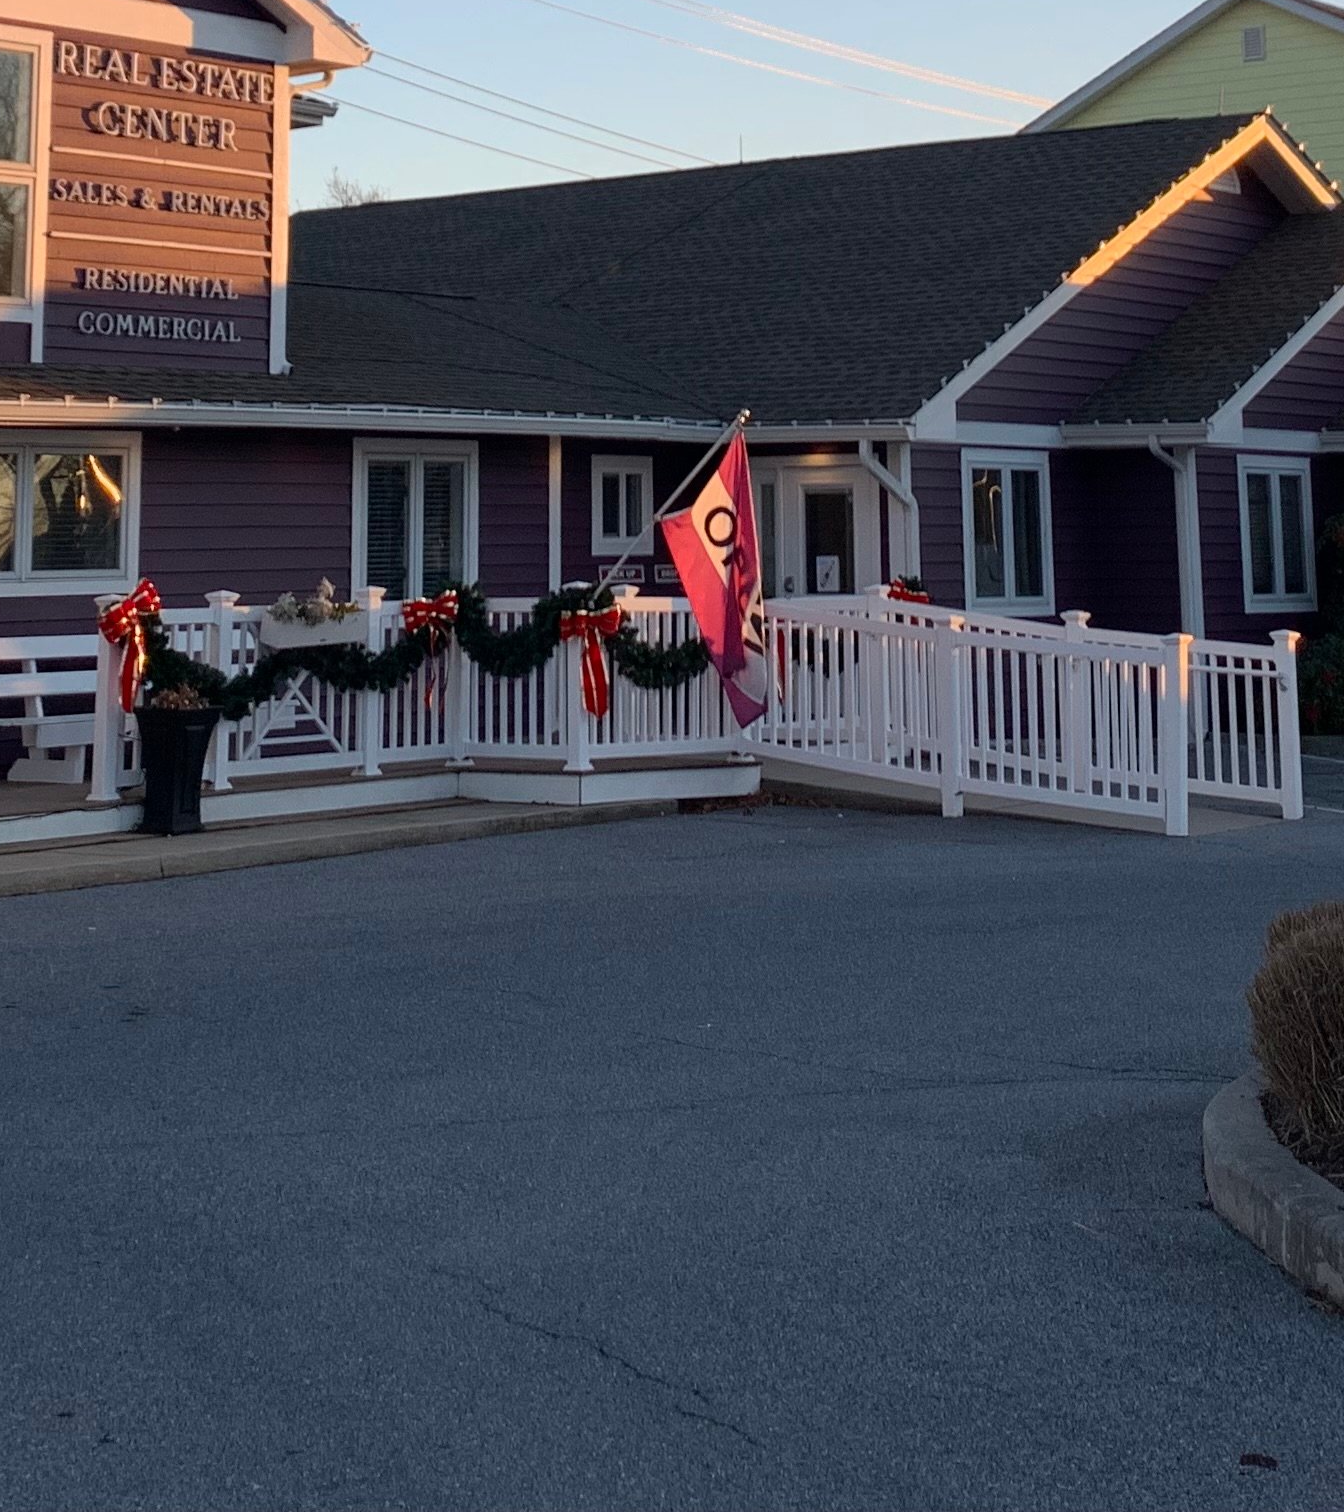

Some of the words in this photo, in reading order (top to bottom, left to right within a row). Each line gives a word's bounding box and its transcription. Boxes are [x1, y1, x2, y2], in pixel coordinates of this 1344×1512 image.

[57, 40, 150, 85] REAL
[161, 57, 274, 104] ESTATE
[98, 101, 239, 152] CENTER
[52, 179, 128, 208] SALES
[140, 188, 156, 210] &
[170, 191, 270, 222] RENTALS
[82, 267, 239, 300] RESIDENTIAL
[78, 311, 241, 342] COMMERCIAL
